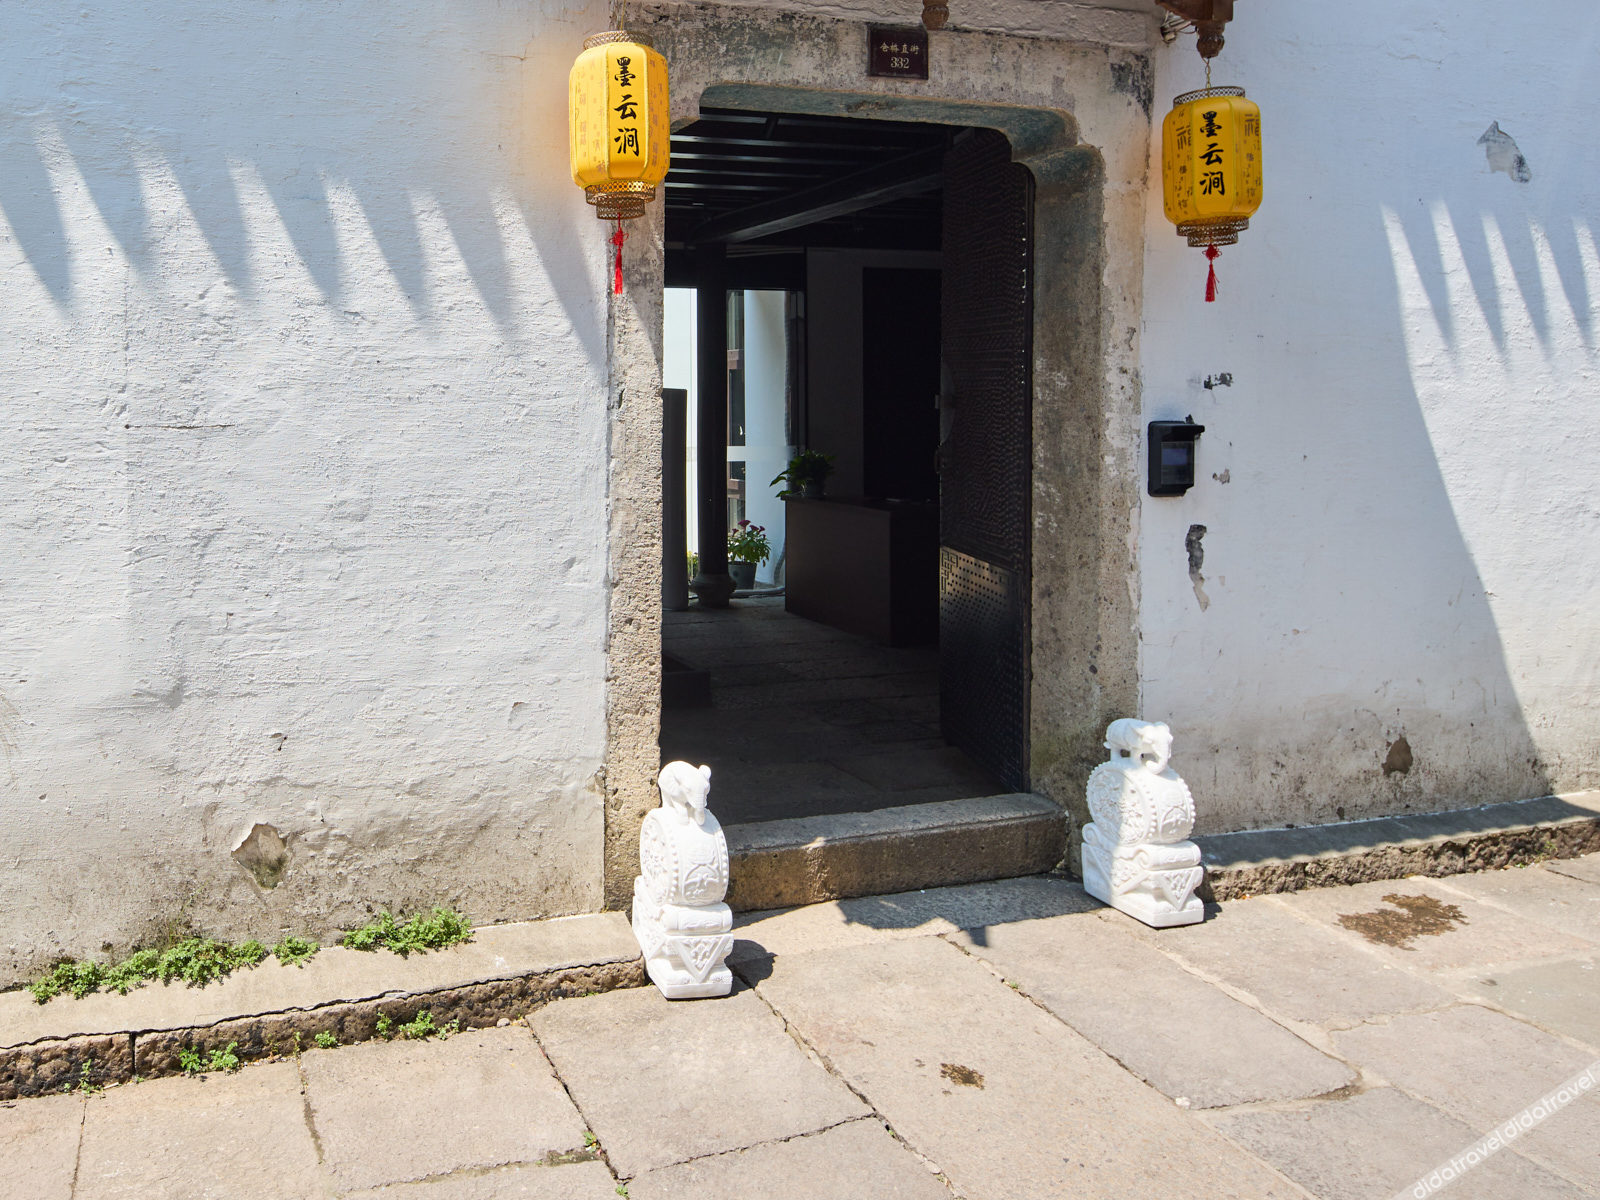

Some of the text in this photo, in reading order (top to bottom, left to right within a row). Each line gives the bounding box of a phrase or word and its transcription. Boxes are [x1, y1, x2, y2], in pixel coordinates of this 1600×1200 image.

[890, 56, 910, 69] 332
[614, 56, 640, 157] 墨云涧
[1199, 110, 1226, 196] 墨云涧
